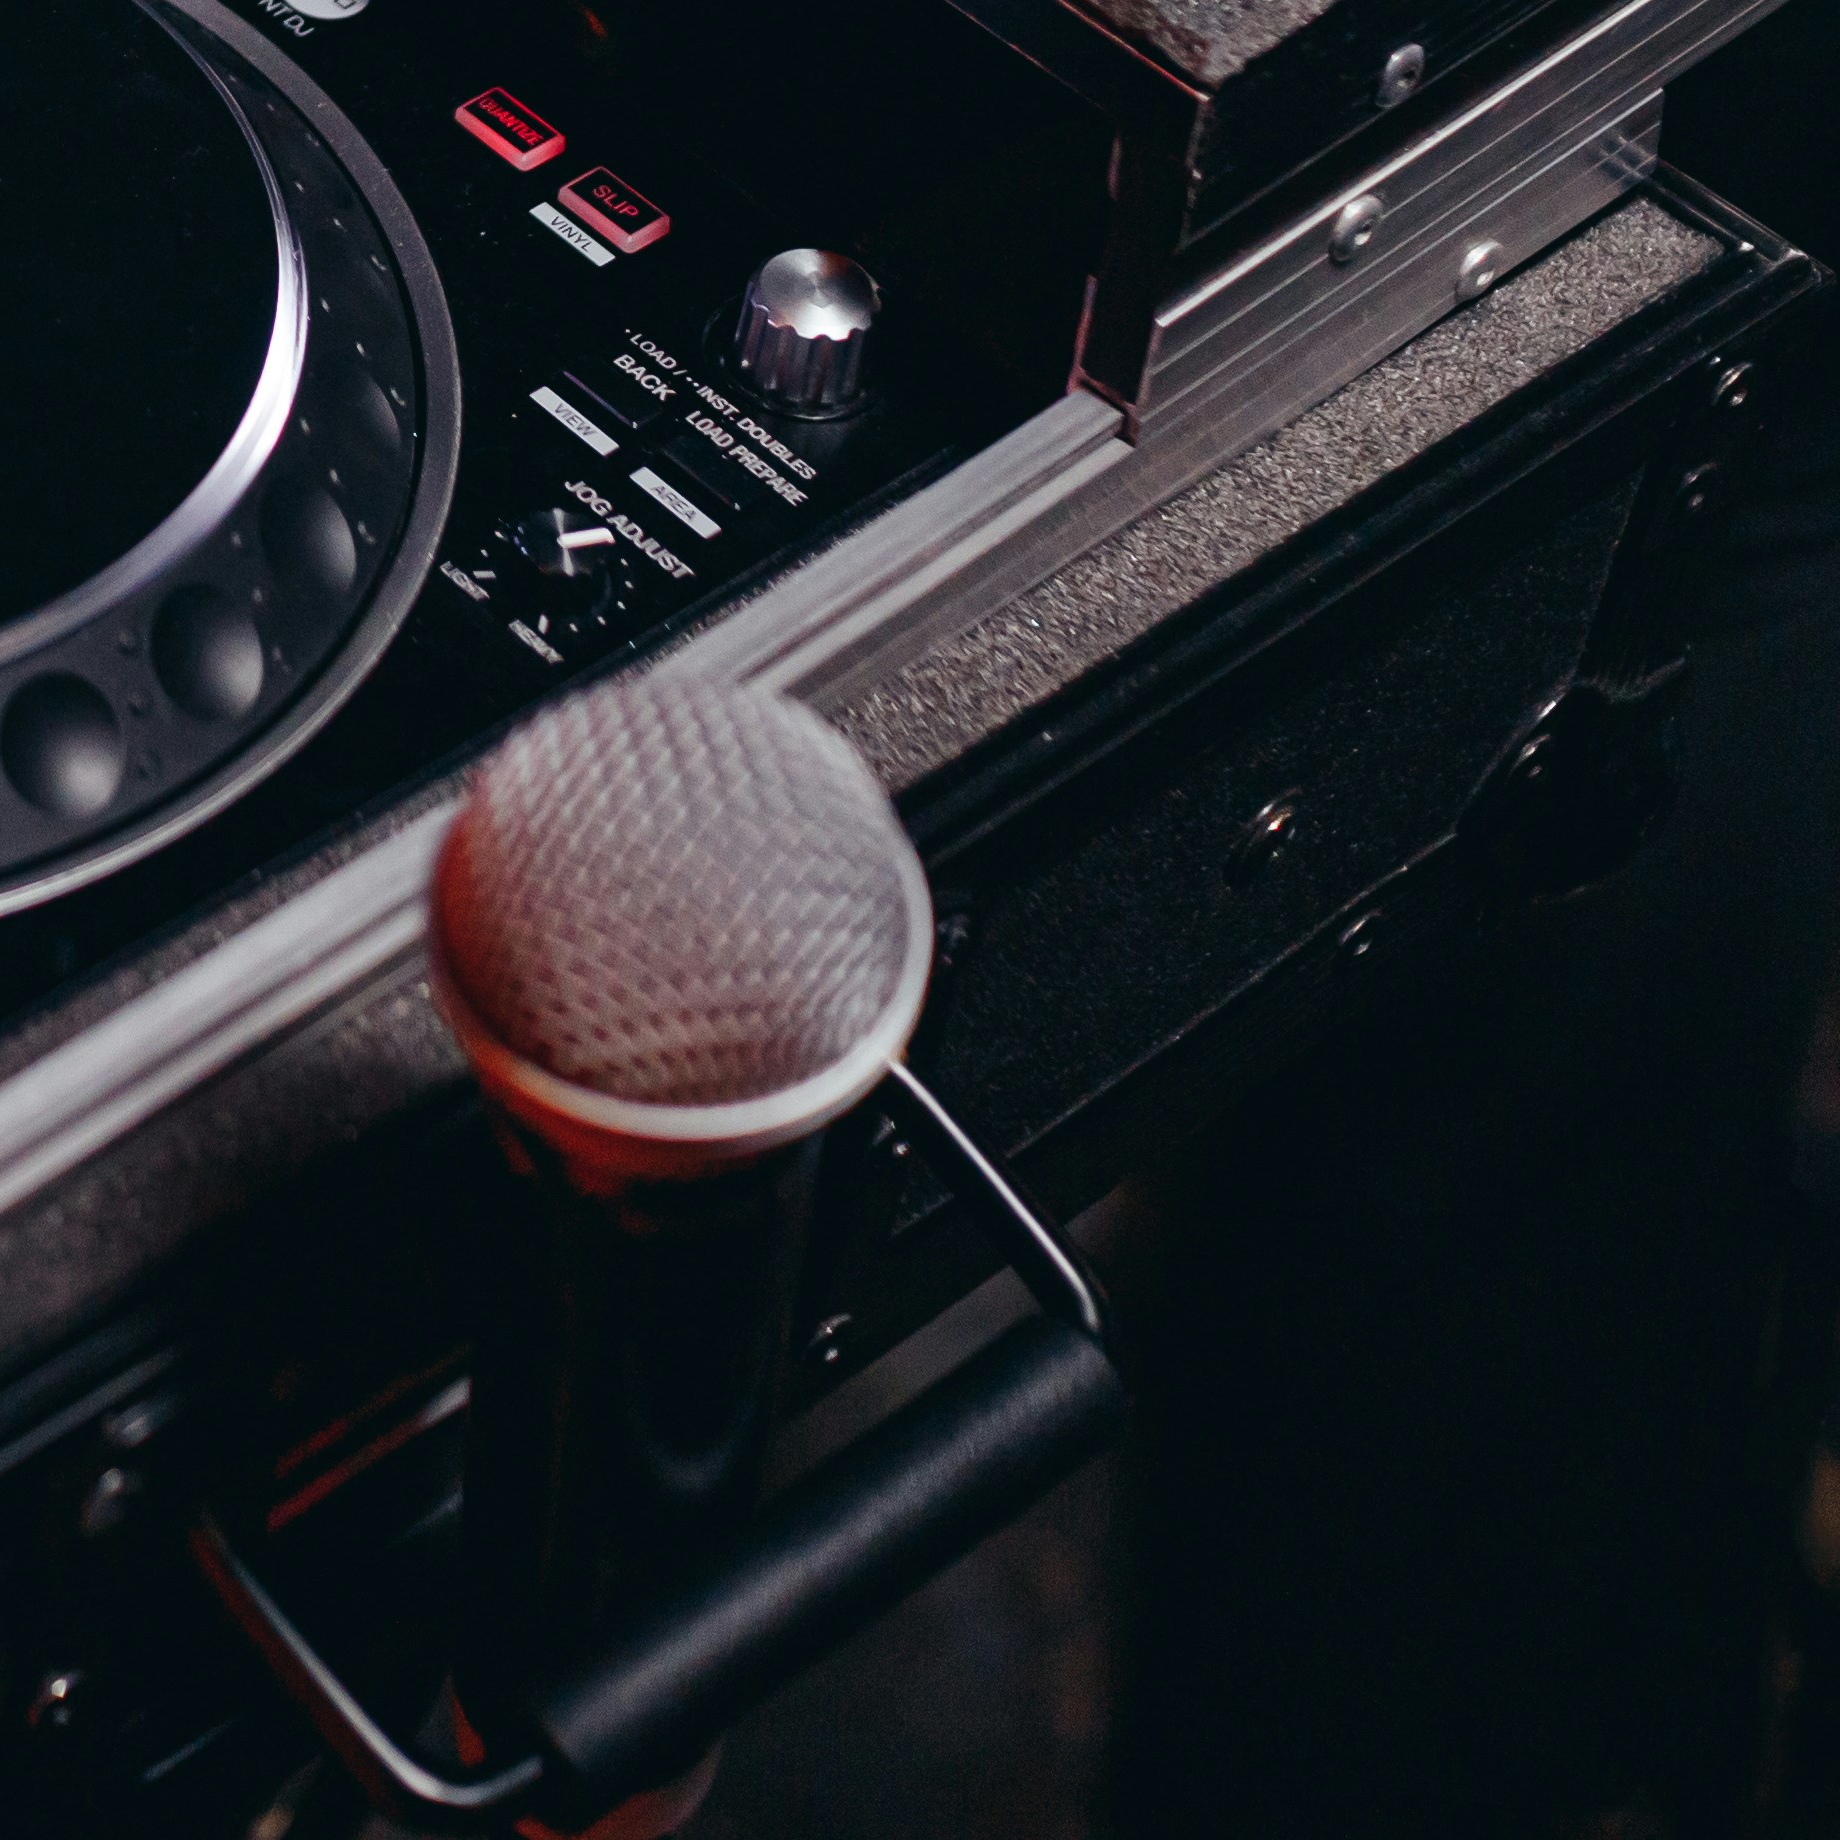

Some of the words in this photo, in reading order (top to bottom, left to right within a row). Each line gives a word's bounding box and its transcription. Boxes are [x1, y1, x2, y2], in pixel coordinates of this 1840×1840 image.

[282, 14, 315, 37] DJ
[477, 96, 544, 146] QUANTIZE
[592, 185, 639, 217] SLIP
[549, 215, 592, 253] VINYL
[613, 354, 677, 402] BACK
[553, 403, 599, 437] VIEW
[630, 333, 677, 370] LOAD
[697, 385, 740, 421] INST.
[737, 417, 817, 481] DOUBLES
[684, 410, 734, 450] LOAD
[729, 444, 809, 507] PREPARE
[650, 485, 697, 521] AREA
[564, 480, 613, 518] JOG
[606, 514, 696, 578] ADJUST
